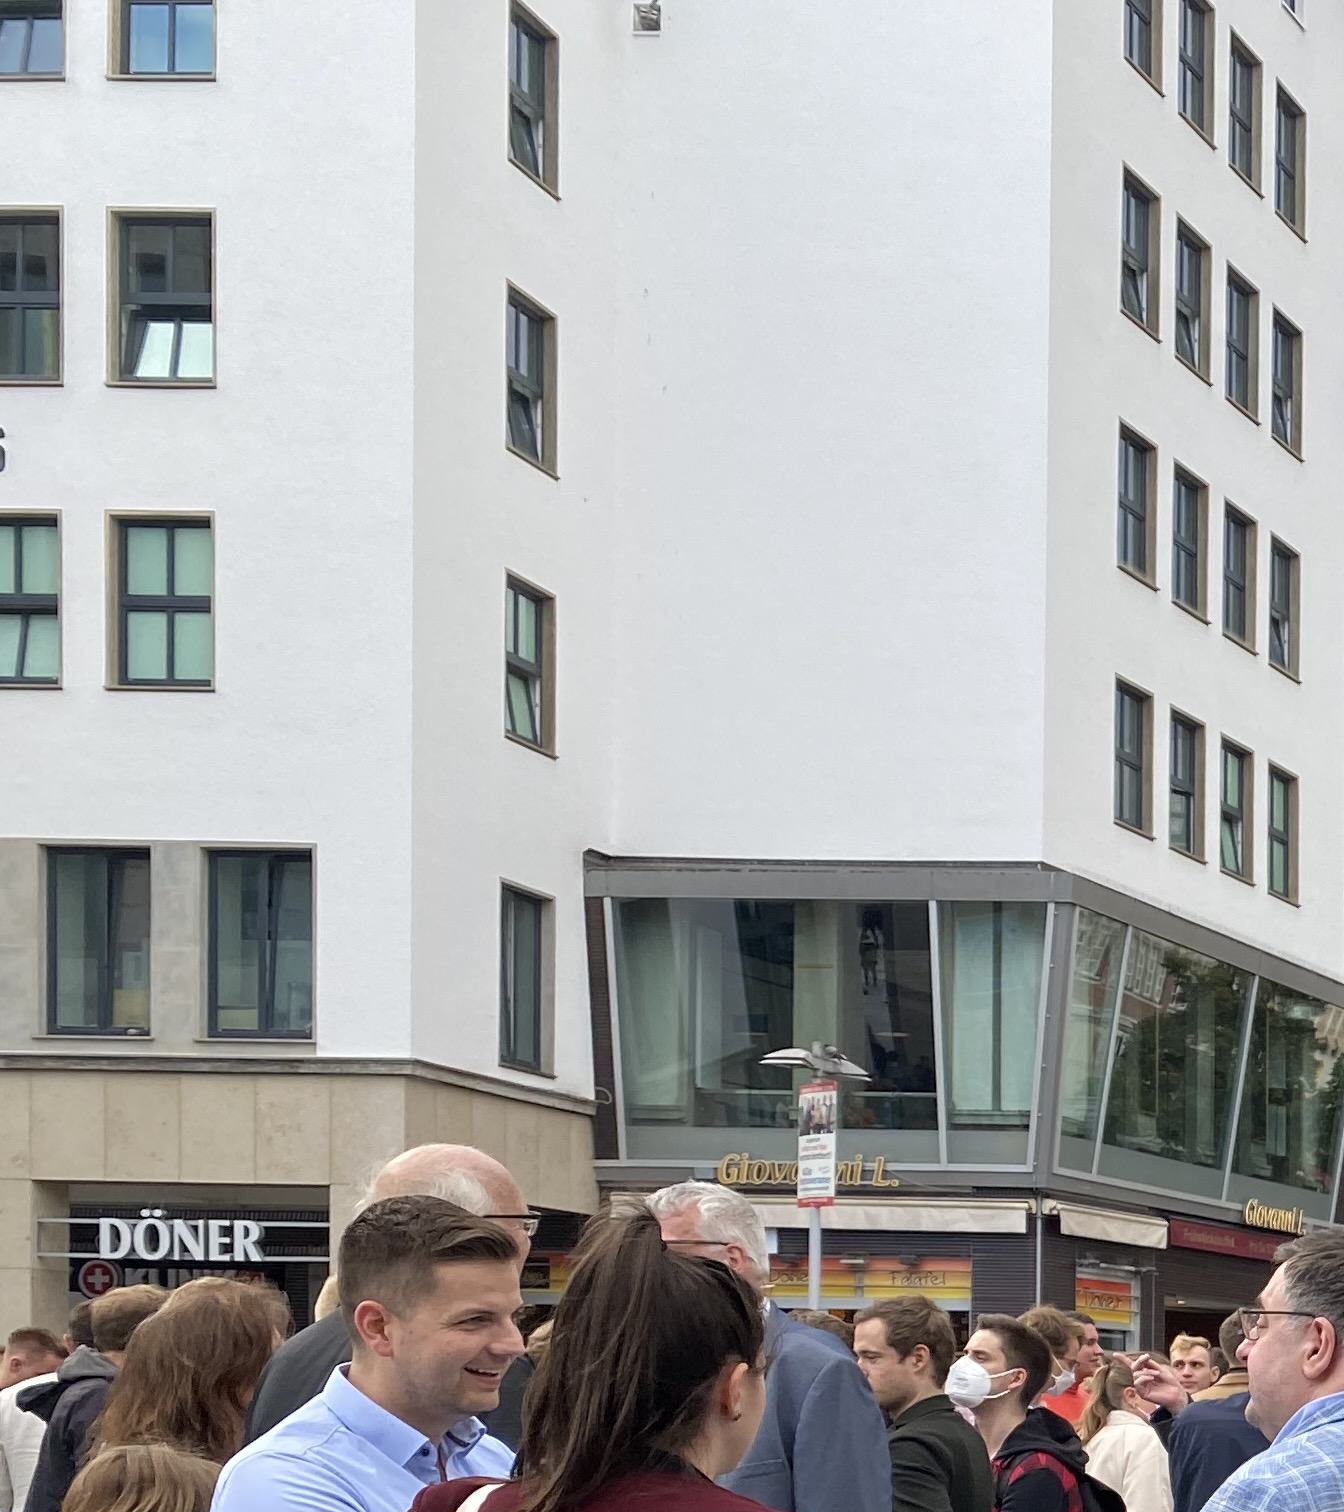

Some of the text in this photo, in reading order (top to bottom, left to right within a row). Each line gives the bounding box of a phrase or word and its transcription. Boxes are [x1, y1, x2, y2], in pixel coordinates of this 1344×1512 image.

[872, 1156, 899, 1187] L.
[99, 1208, 263, 1262] DÖNER
[889, 1270, 947, 1286] Falafel
